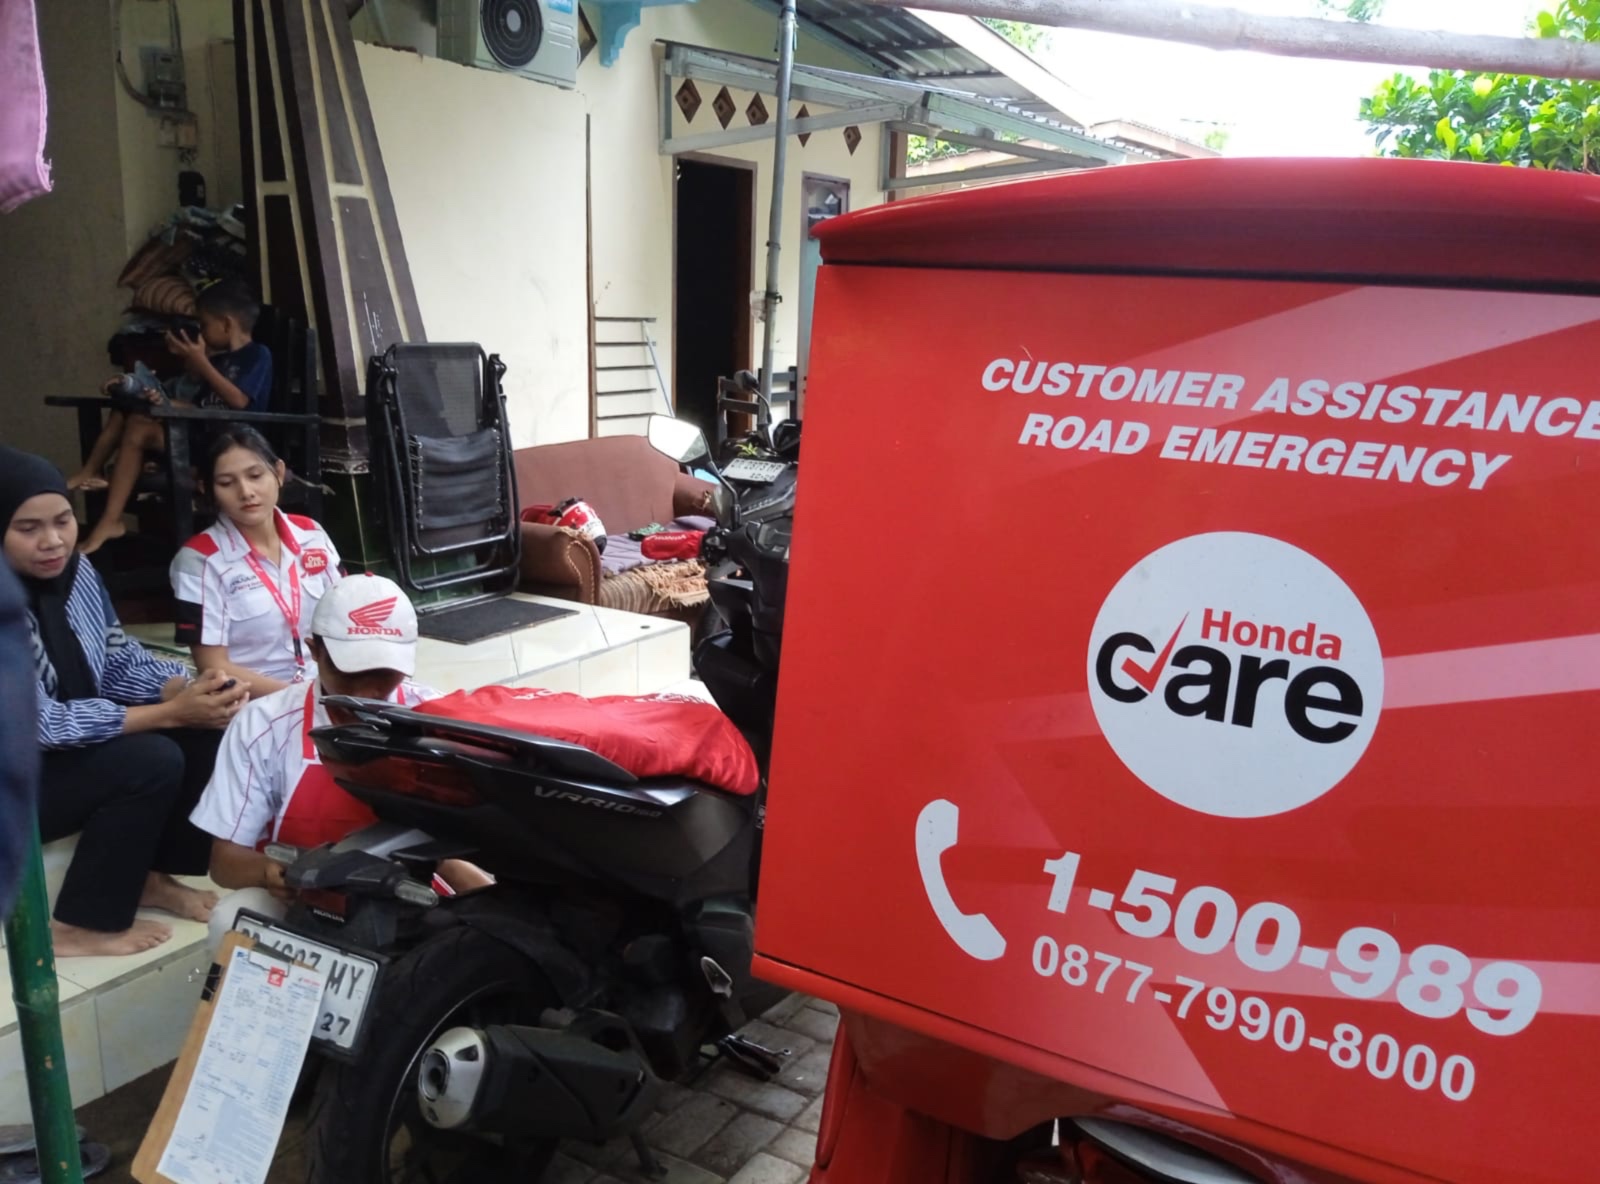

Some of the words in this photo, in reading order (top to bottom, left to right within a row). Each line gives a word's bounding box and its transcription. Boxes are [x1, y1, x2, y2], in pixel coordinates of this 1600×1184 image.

[981, 358, 1245, 410] CUSTOMER
[1251, 377, 1600, 440] ASSISTANCE
[1018, 413, 1151, 455] ROAD
[1159, 425, 1513, 490] EMERGENCY
[347, 626, 404, 637] HONDA
[1200, 607, 1343, 662] Honda
[1095, 631, 1364, 745] care
[534, 785, 637, 814] VARIO
[324, 958, 365, 1001] MY
[1042, 850, 1543, 1037] 1-500-989
[1031, 934, 1477, 1102] 0877-7990-8000
